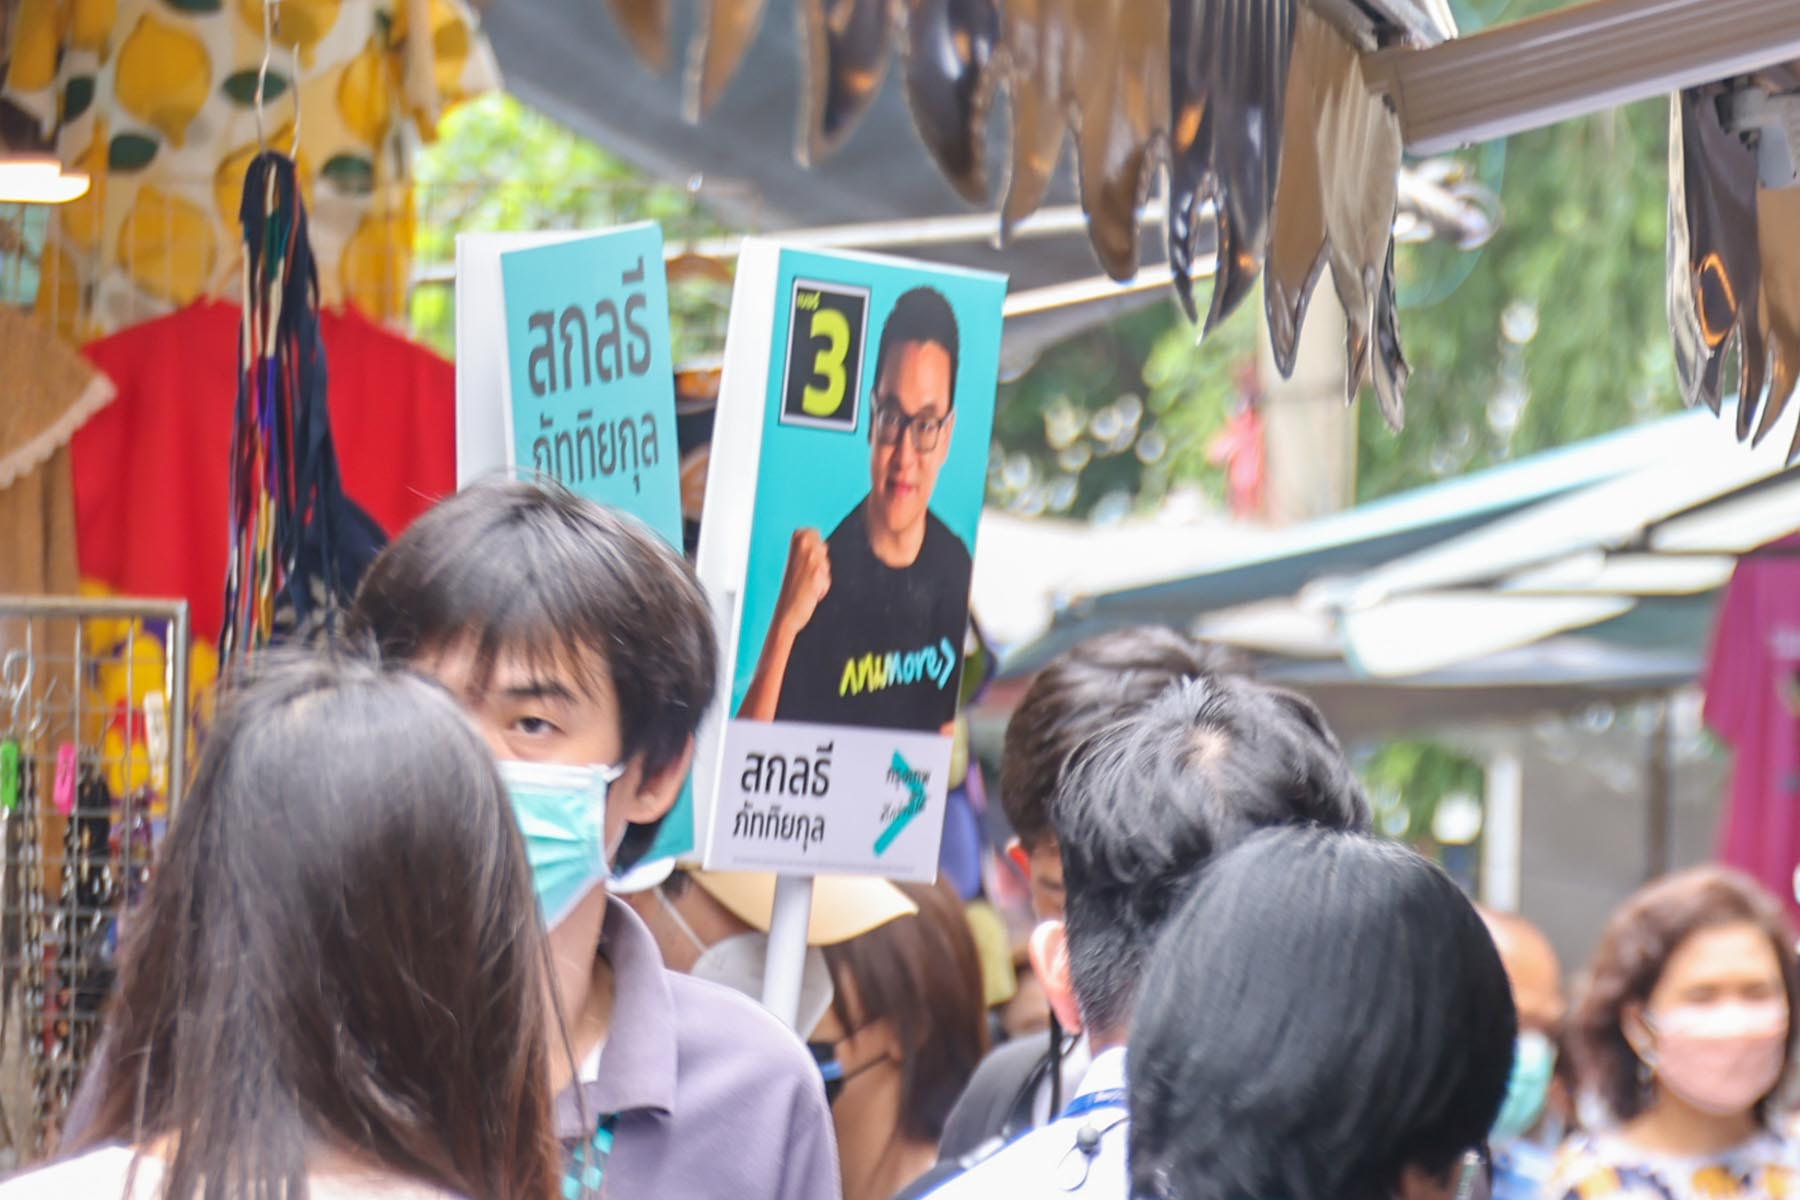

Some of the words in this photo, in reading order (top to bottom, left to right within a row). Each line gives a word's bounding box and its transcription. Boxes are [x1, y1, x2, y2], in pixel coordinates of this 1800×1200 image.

[528, 255, 652, 397] สกลธี
[802, 308, 850, 417] 3
[741, 741, 834, 797] สกลธี
[733, 800, 826, 853] ภัททิยกุล
